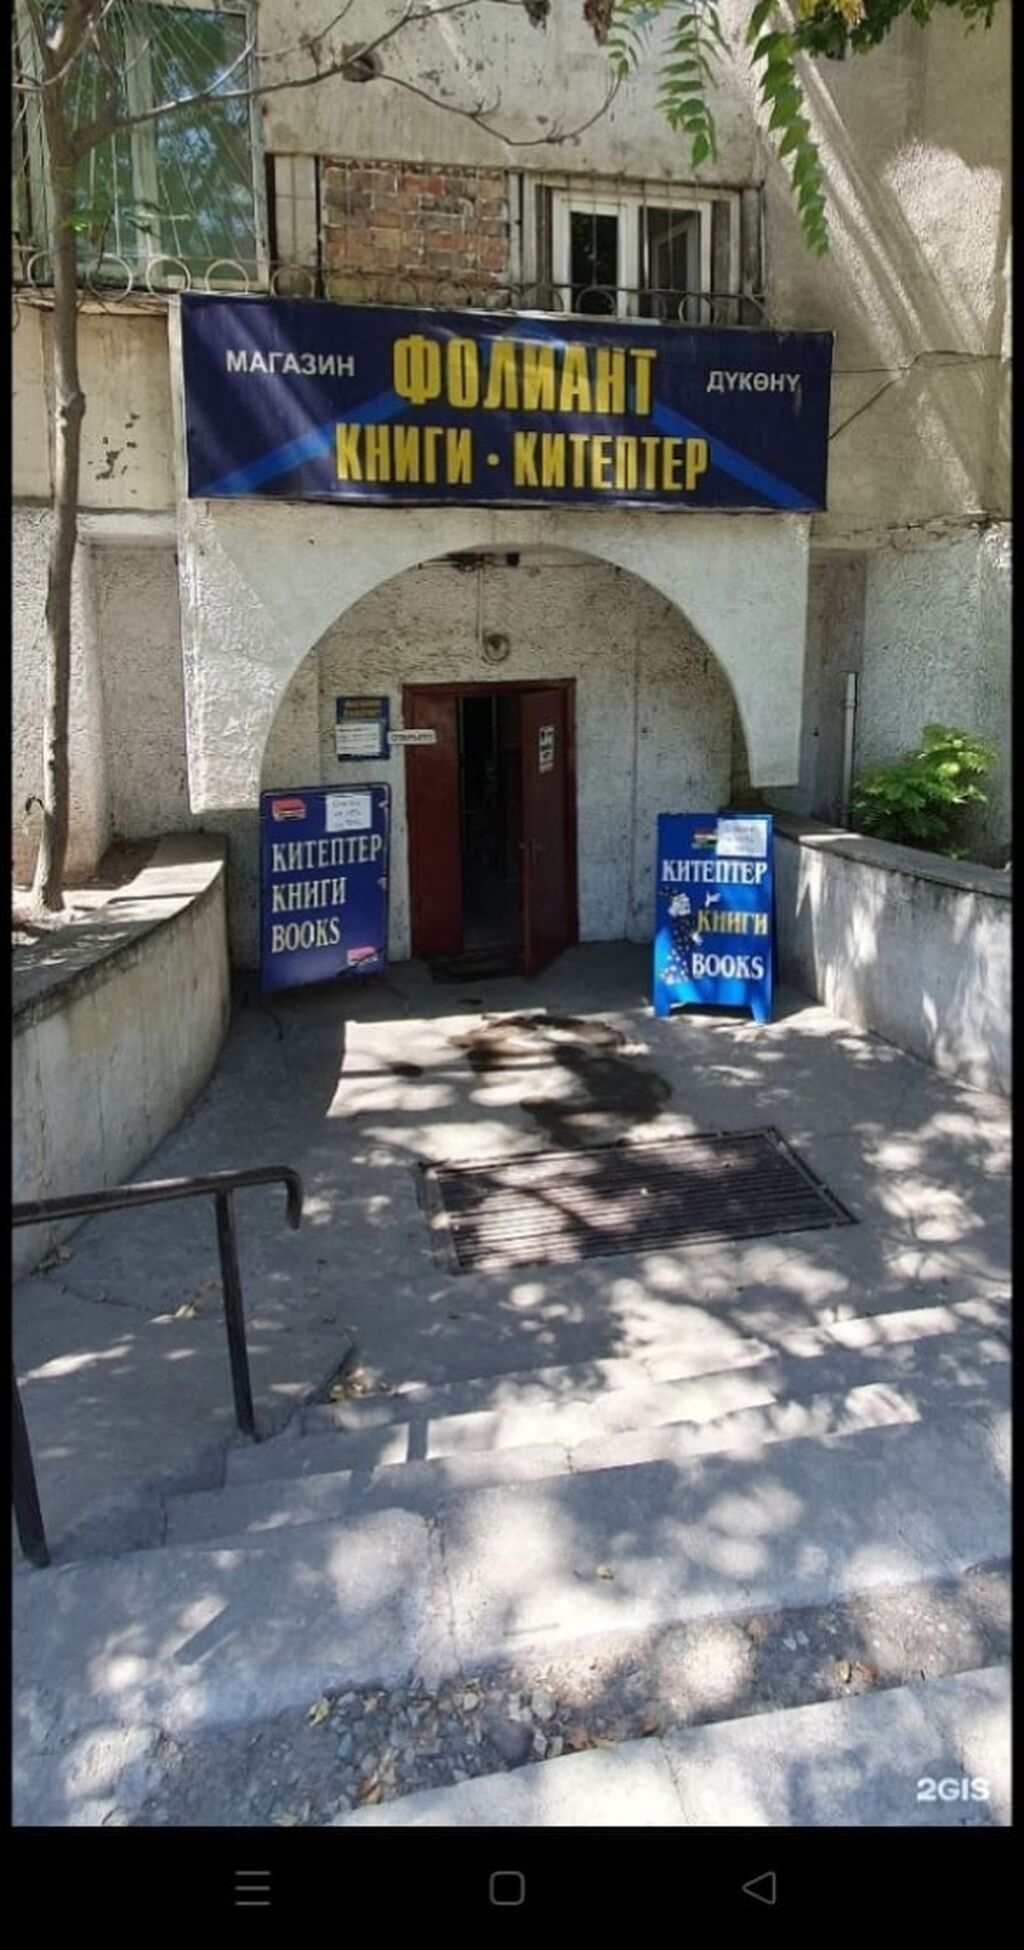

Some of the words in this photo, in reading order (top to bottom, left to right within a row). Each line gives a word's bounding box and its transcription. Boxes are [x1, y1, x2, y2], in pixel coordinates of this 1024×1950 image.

[225, 350, 355, 377] МАГАЗИН
[393, 334, 657, 415] ФОЛИАНТ
[706, 370, 800, 393] ДҮКӨНҮ
[335, 422, 473, 484] КНИГИ
[513, 431, 708, 491] КИТЕПТЕР
[272, 834, 382, 872] КИТЕПТЕР
[662, 859, 768, 884] КИТЕПТЕР
[271, 877, 347, 913] КНИГИ
[271, 917, 341, 953] BOOKS
[698, 910, 768, 935] КНИГИ
[691, 953, 765, 980] BOOKS
